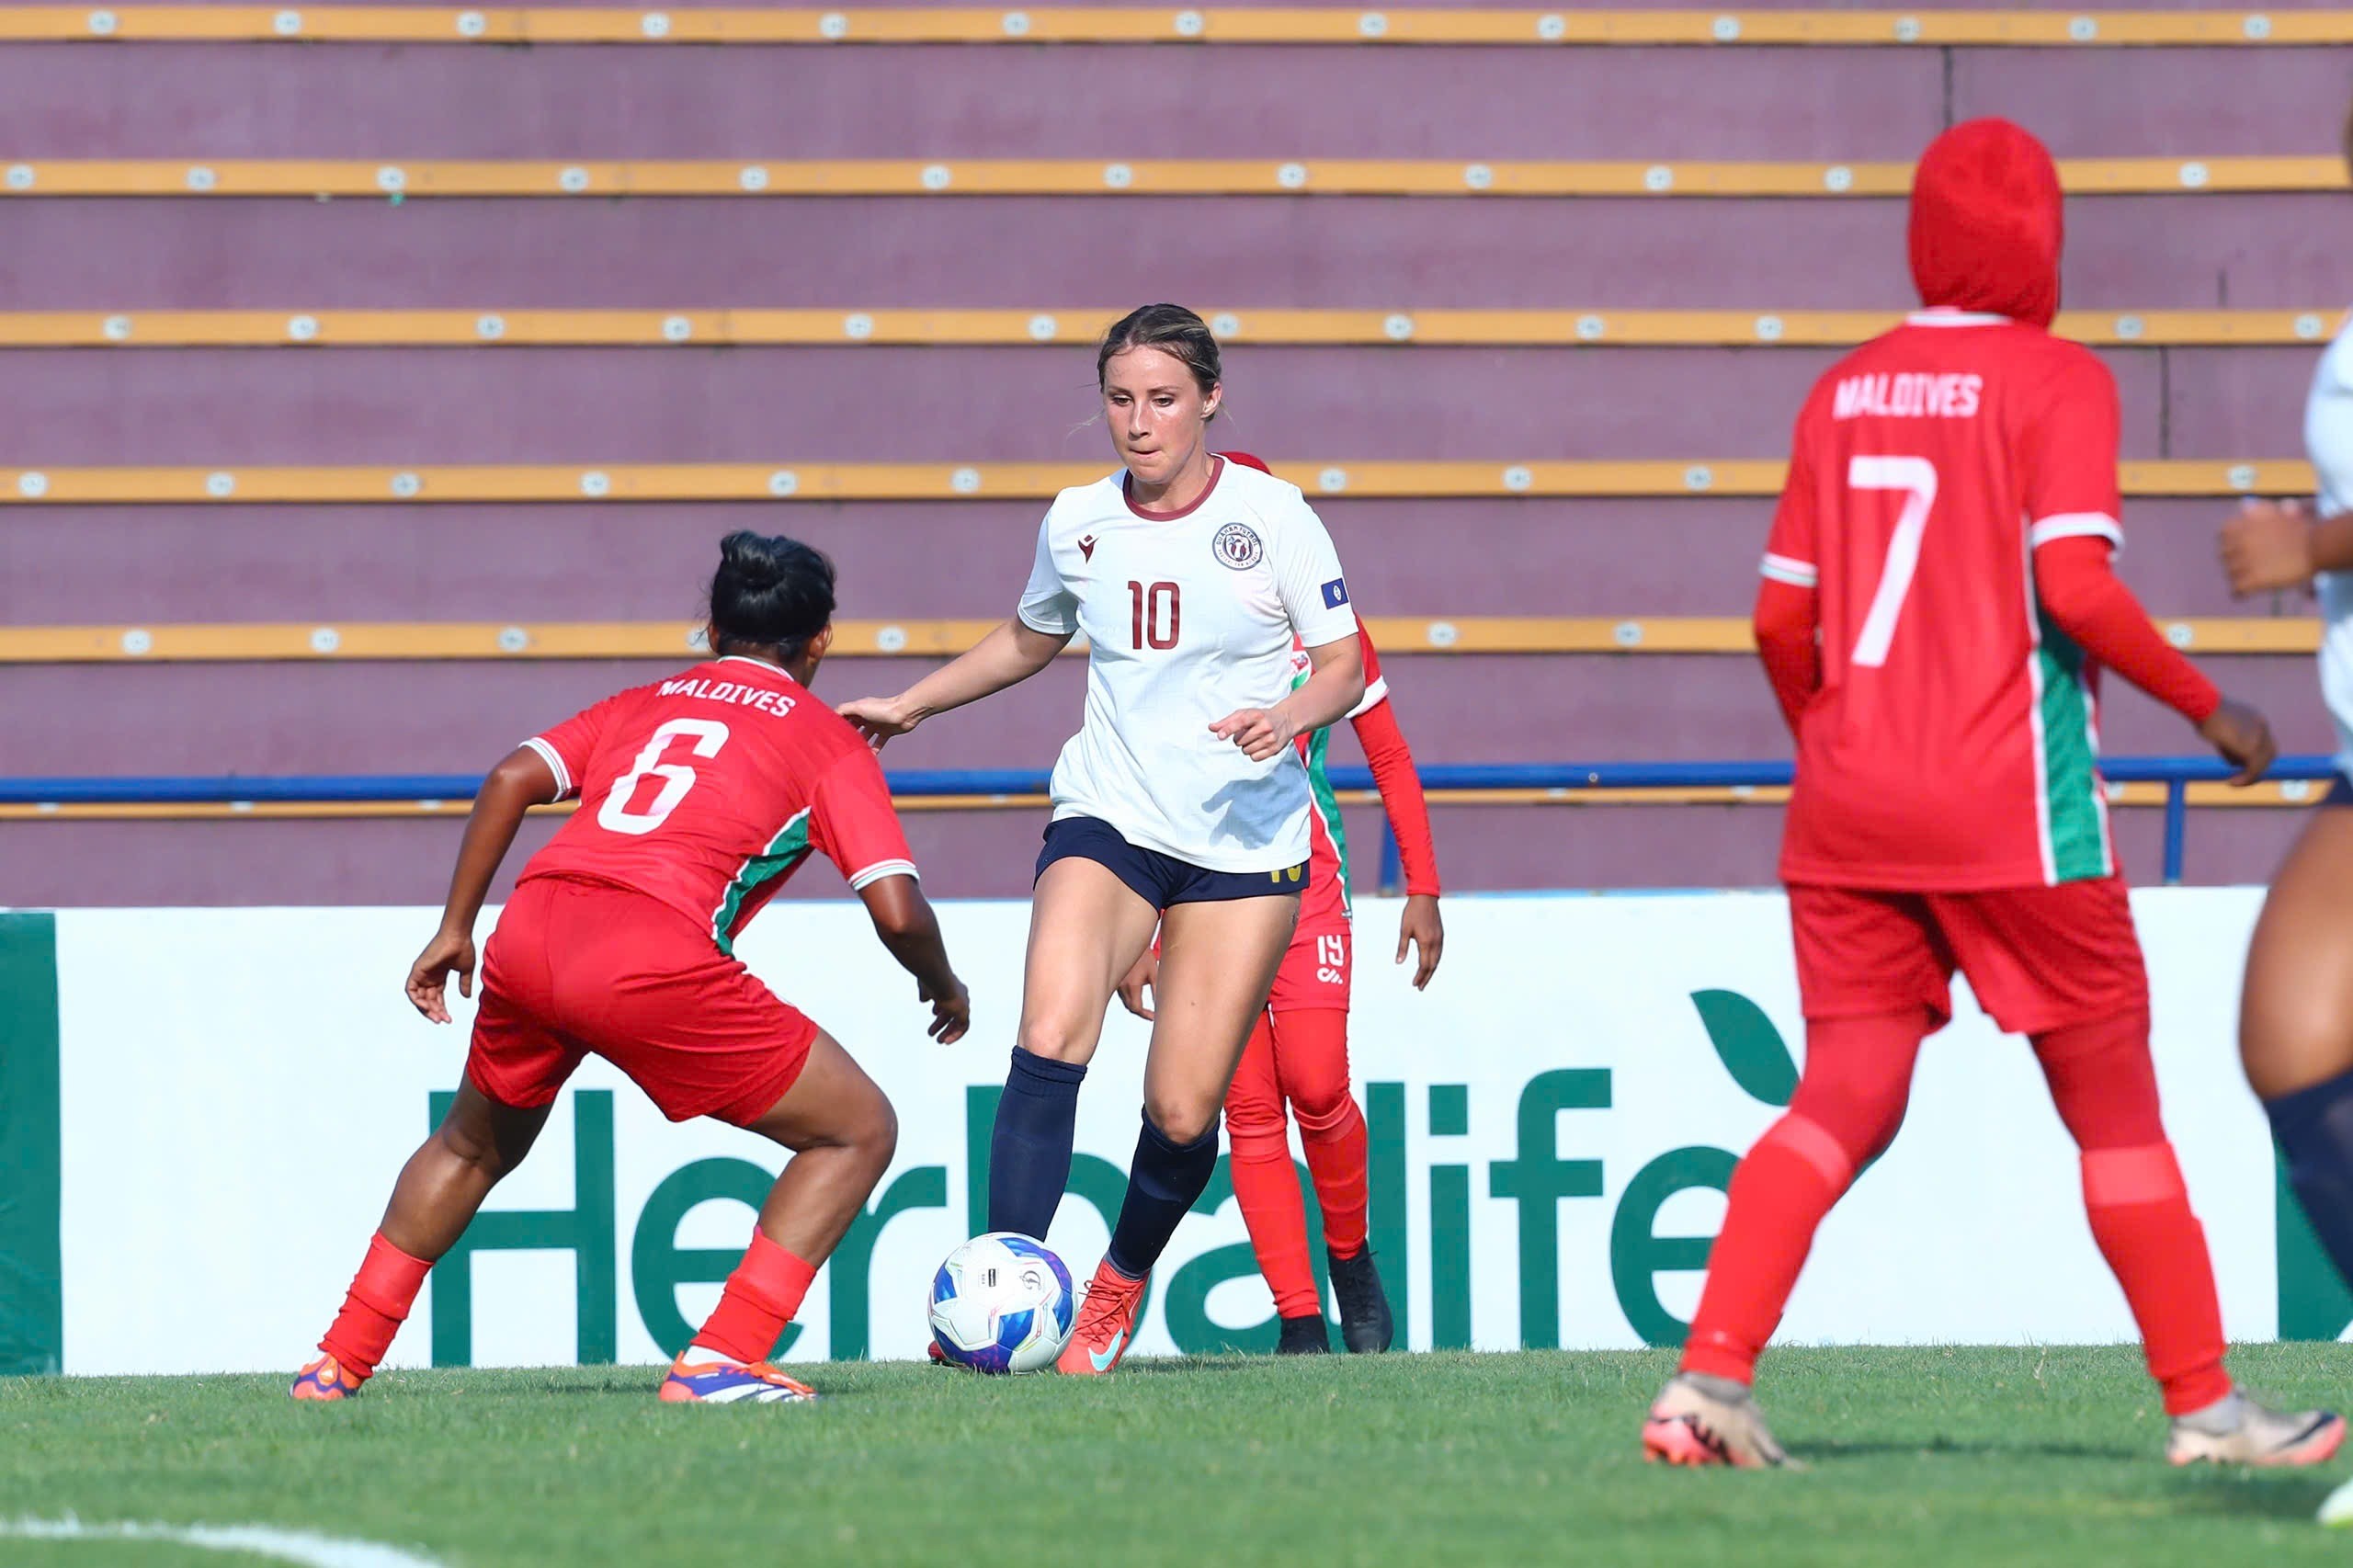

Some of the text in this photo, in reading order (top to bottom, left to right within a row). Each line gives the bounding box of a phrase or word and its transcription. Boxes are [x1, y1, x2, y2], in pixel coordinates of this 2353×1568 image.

[1832, 372, 1983, 419] MALDIVES
[1847, 455, 1938, 667] 7
[1127, 580, 1180, 650] 10
[655, 679, 797, 717] MALDIVES
[597, 718, 730, 835] 6
[1317, 935, 1344, 966] 19
